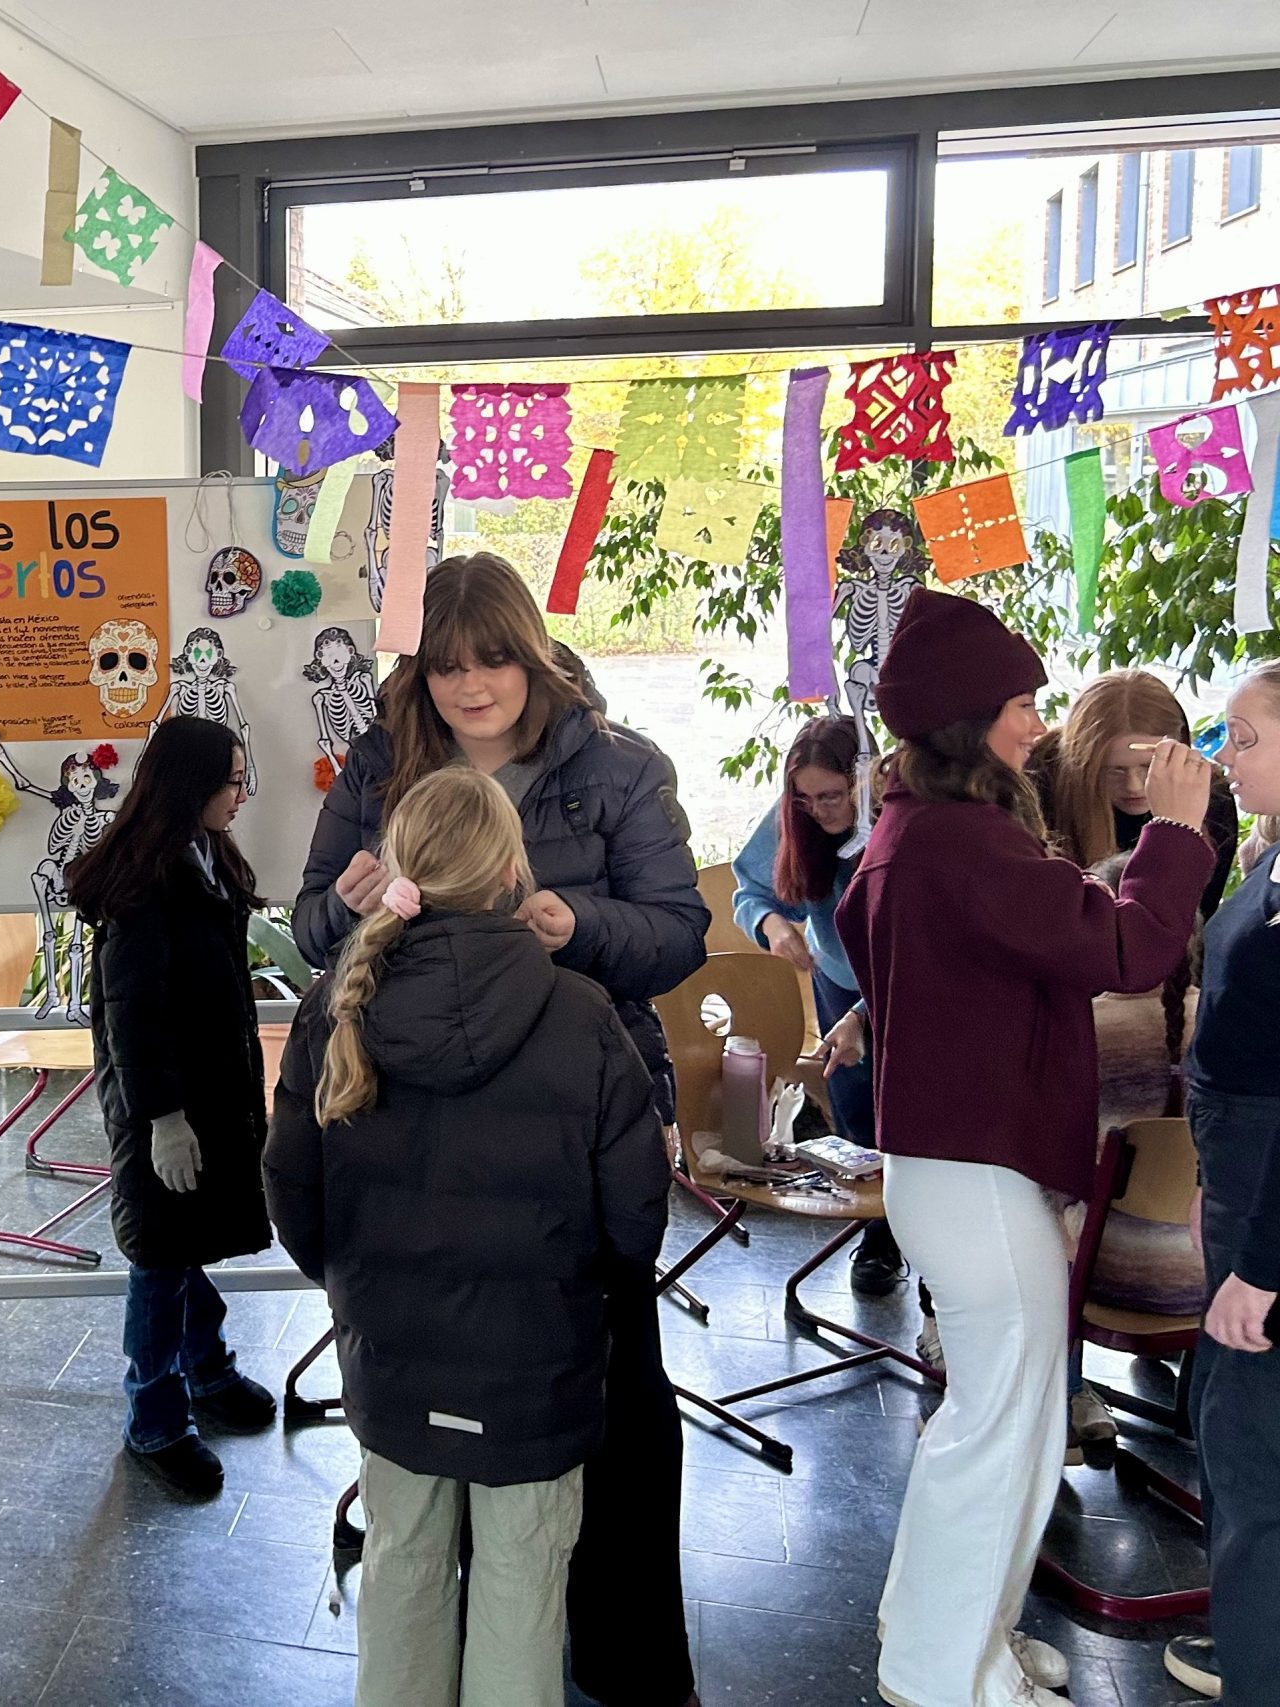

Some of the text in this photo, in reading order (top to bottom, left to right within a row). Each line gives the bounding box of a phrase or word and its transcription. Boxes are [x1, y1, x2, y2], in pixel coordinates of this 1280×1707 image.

[48, 500, 119, 550] los
[28, 614, 59, 623] México
[3, 626, 12, 634] el
[33, 625, 80, 633] noviembre
[40, 633, 80, 641] ofrendas
